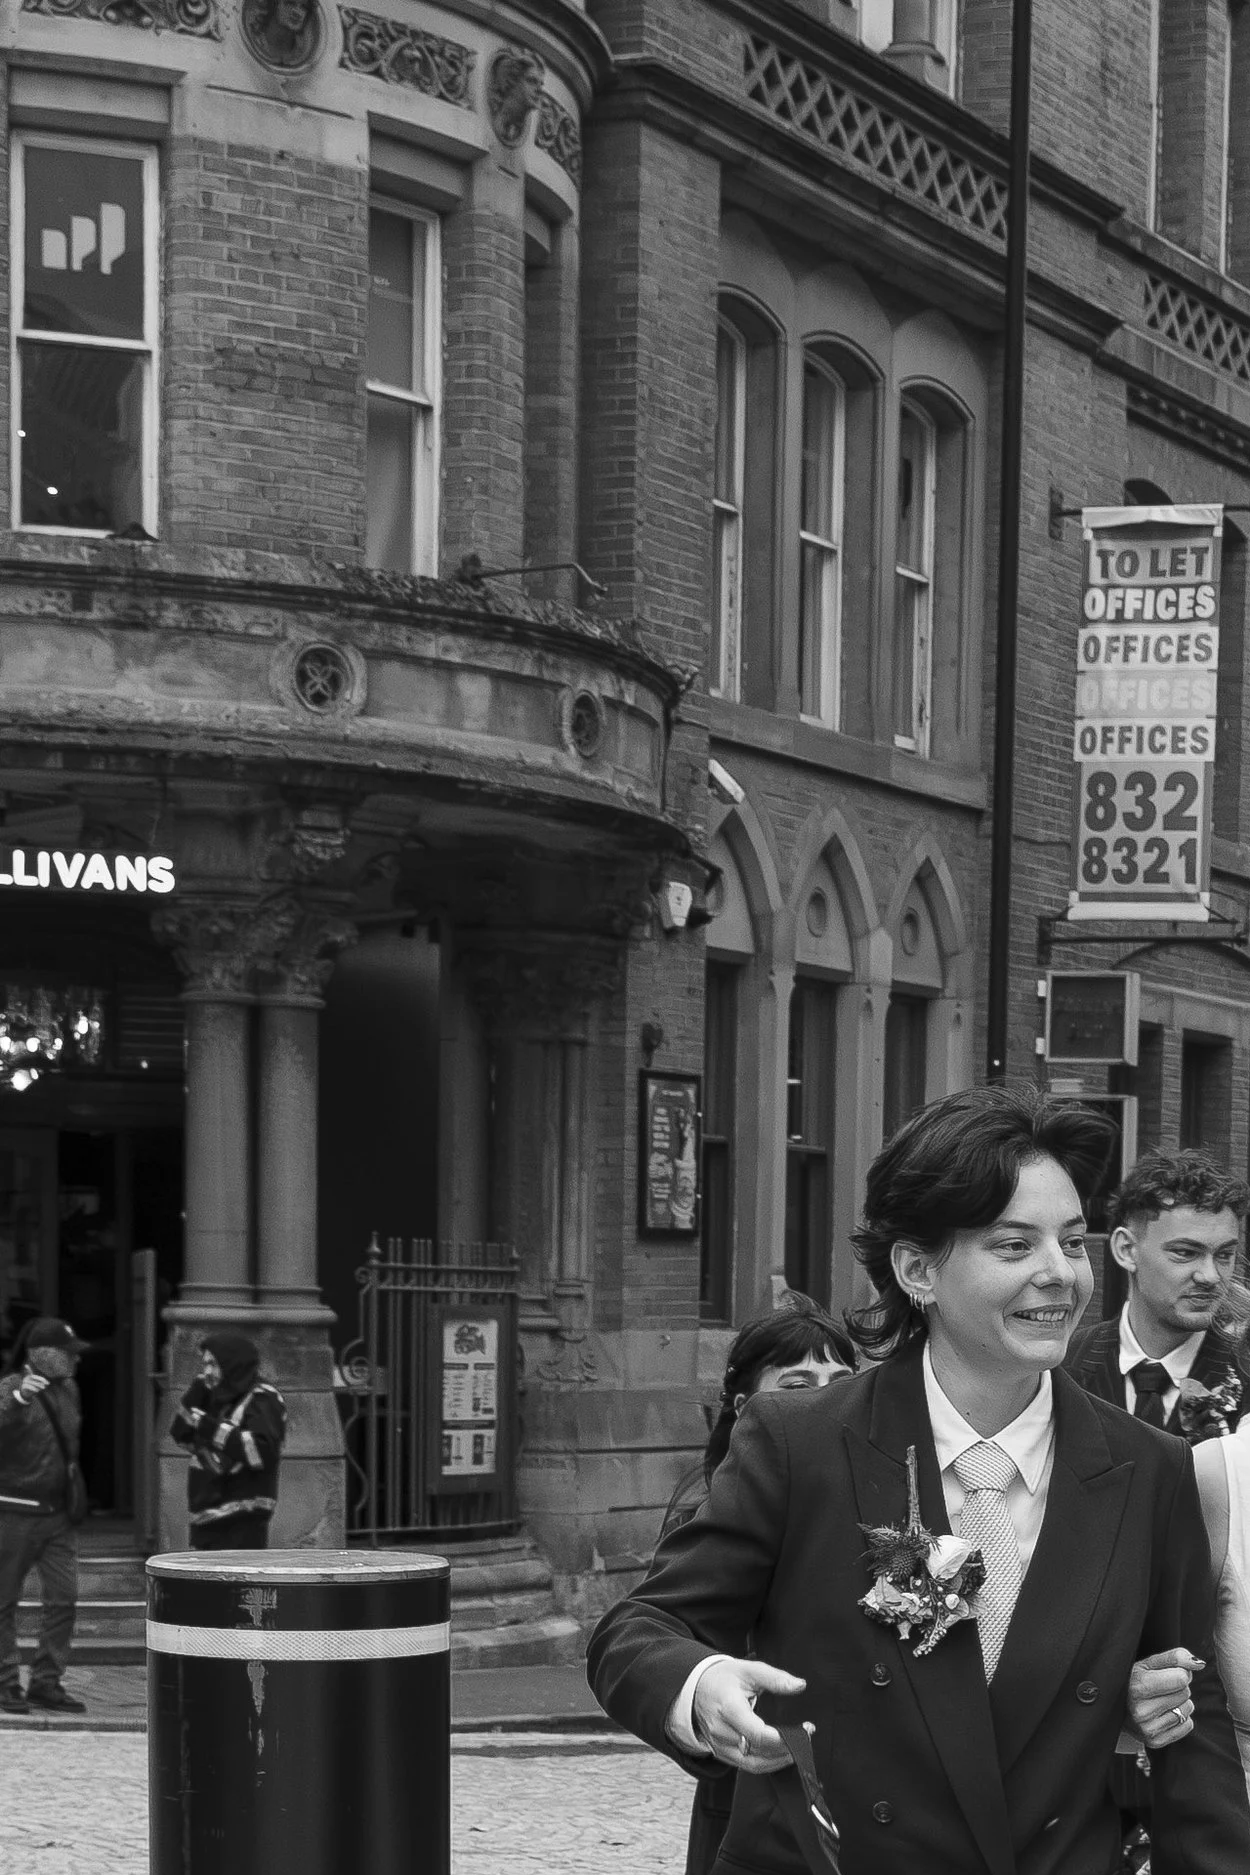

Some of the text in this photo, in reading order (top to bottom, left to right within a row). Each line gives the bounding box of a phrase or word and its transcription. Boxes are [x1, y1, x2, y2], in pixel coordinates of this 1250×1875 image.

[1095, 545, 1211, 580] TO LET
[1083, 584, 1216, 622] OFFICES
[1082, 632, 1214, 664] OFFICES
[1080, 677, 1213, 712] OFFICES
[1078, 724, 1210, 756] OFFICES
[1084, 770, 1199, 832] 832
[1082, 836, 1197, 885] 8321
